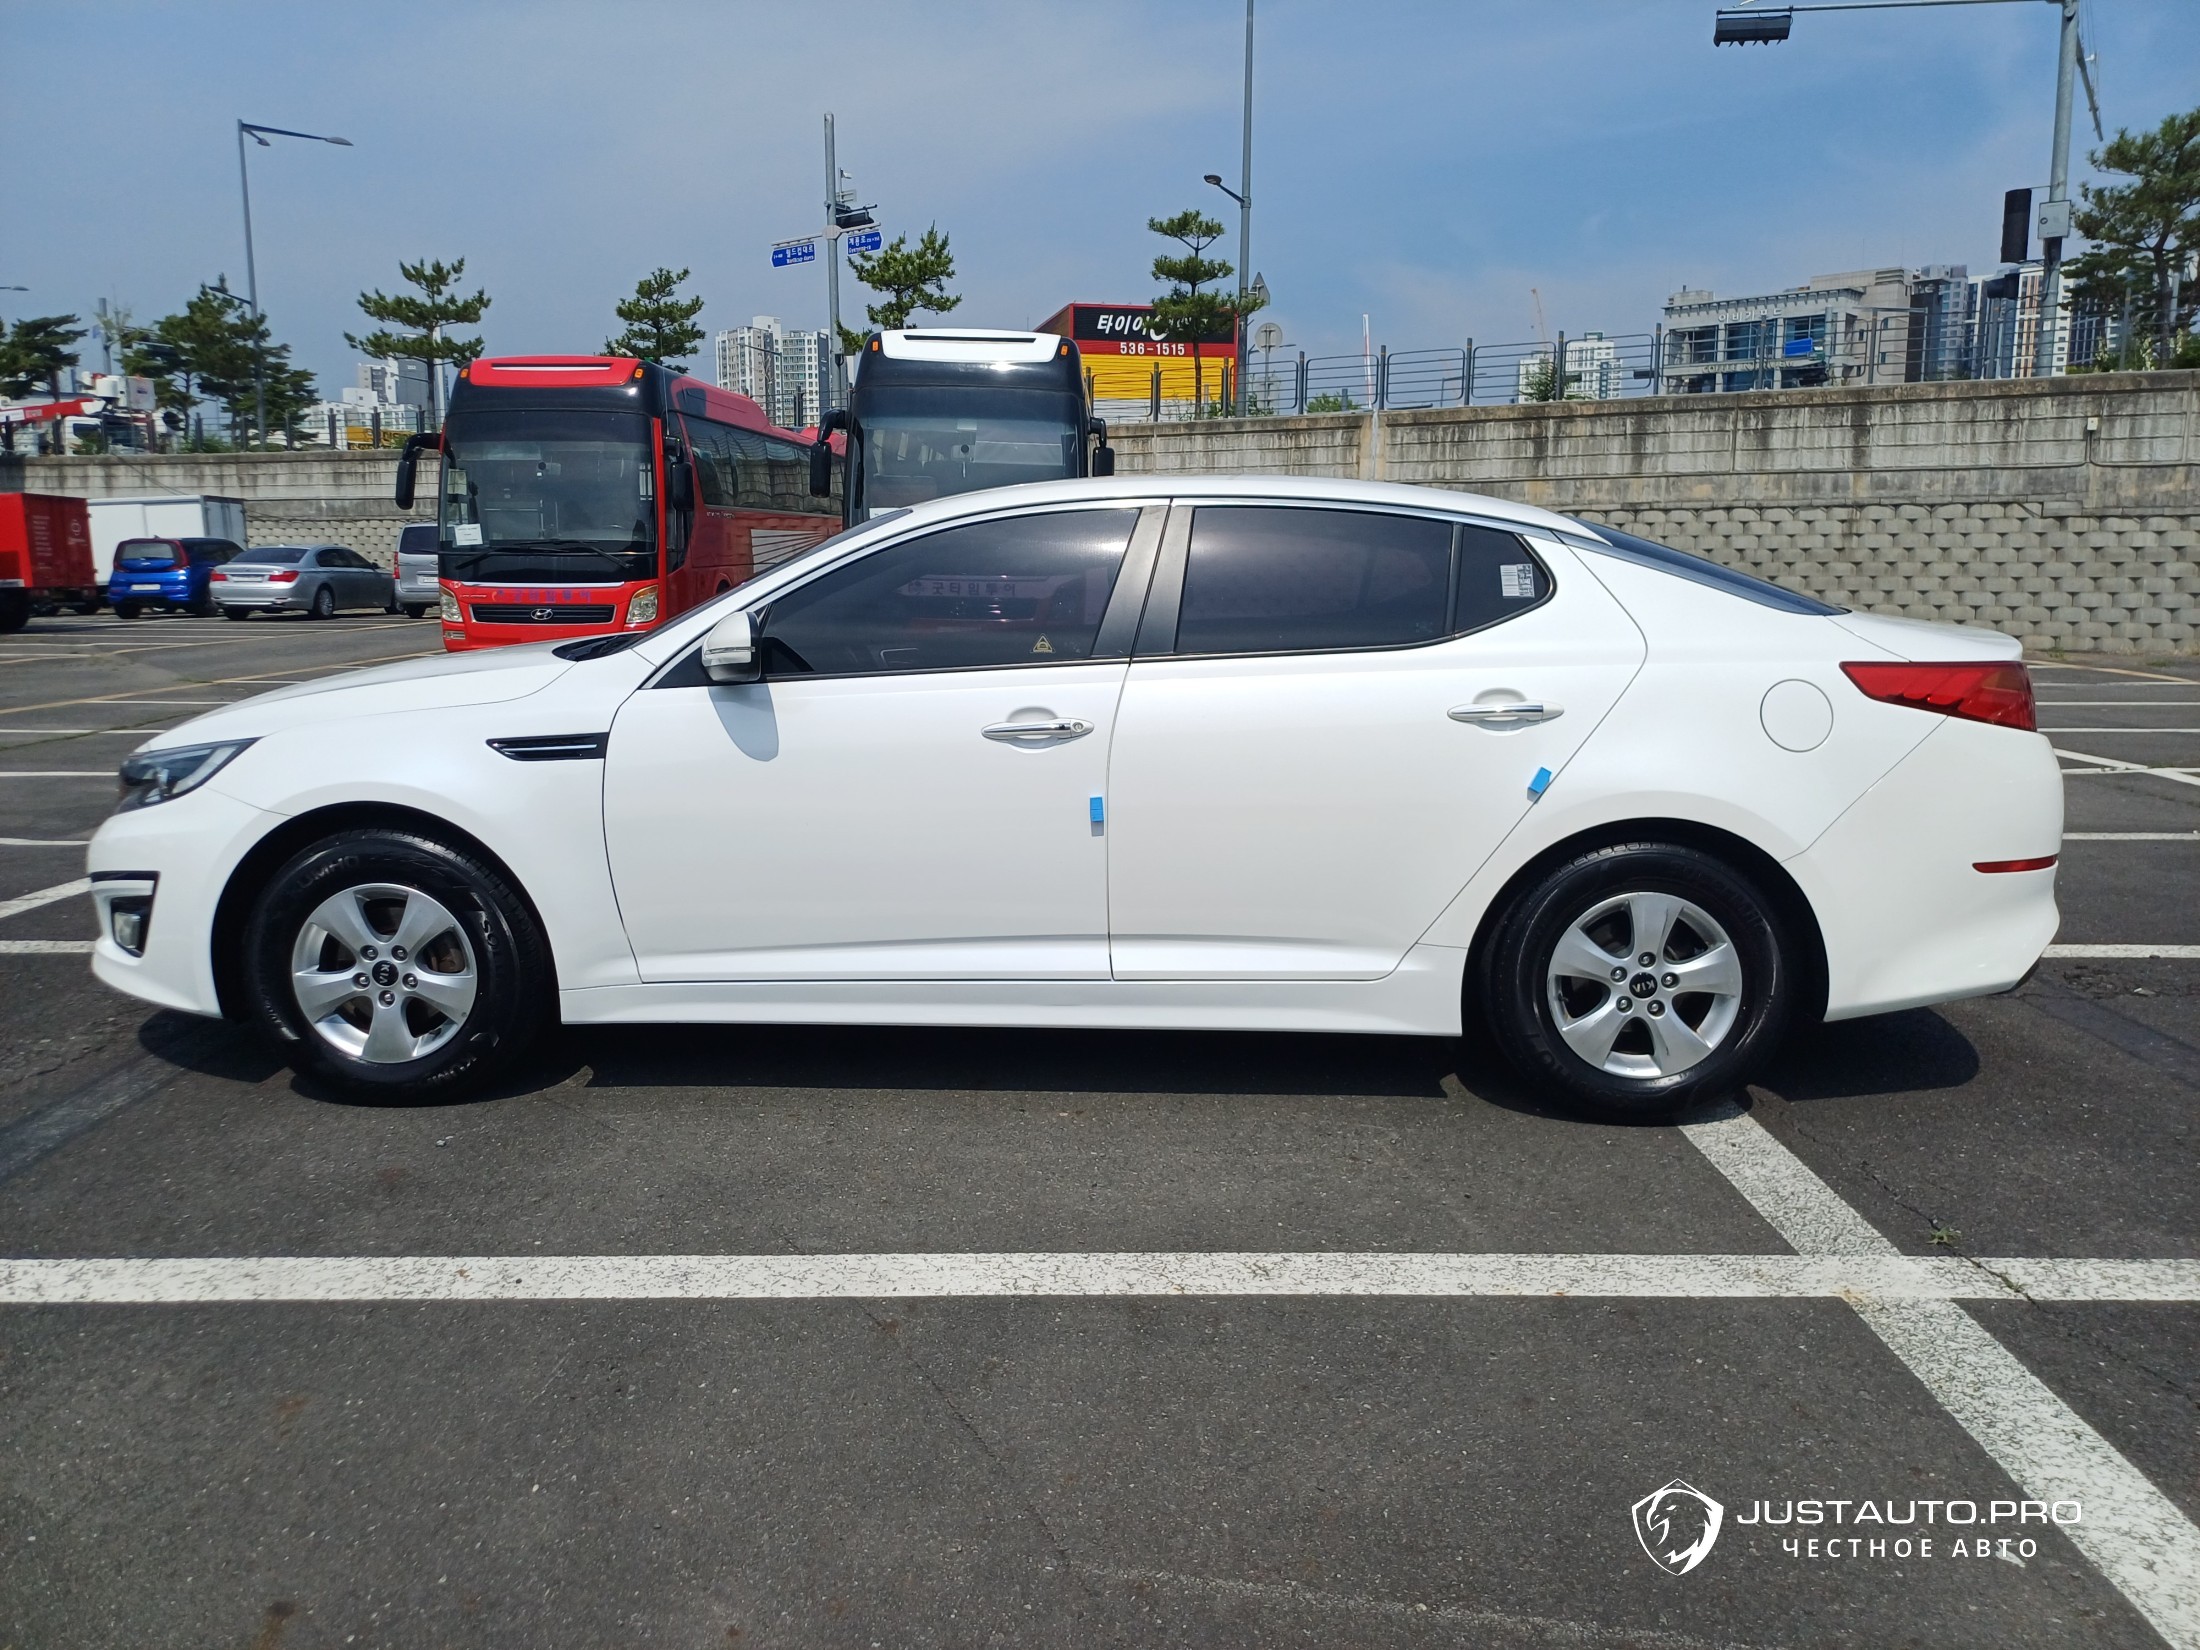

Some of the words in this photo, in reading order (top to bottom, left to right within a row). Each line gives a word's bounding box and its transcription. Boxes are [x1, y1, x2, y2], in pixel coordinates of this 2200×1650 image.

[786, 245, 814, 258] 월드컵대로
[1120, 342, 1185, 356] 536-1515
[379, 963, 391, 984] KIA
[1632, 980, 1655, 993] KIA
